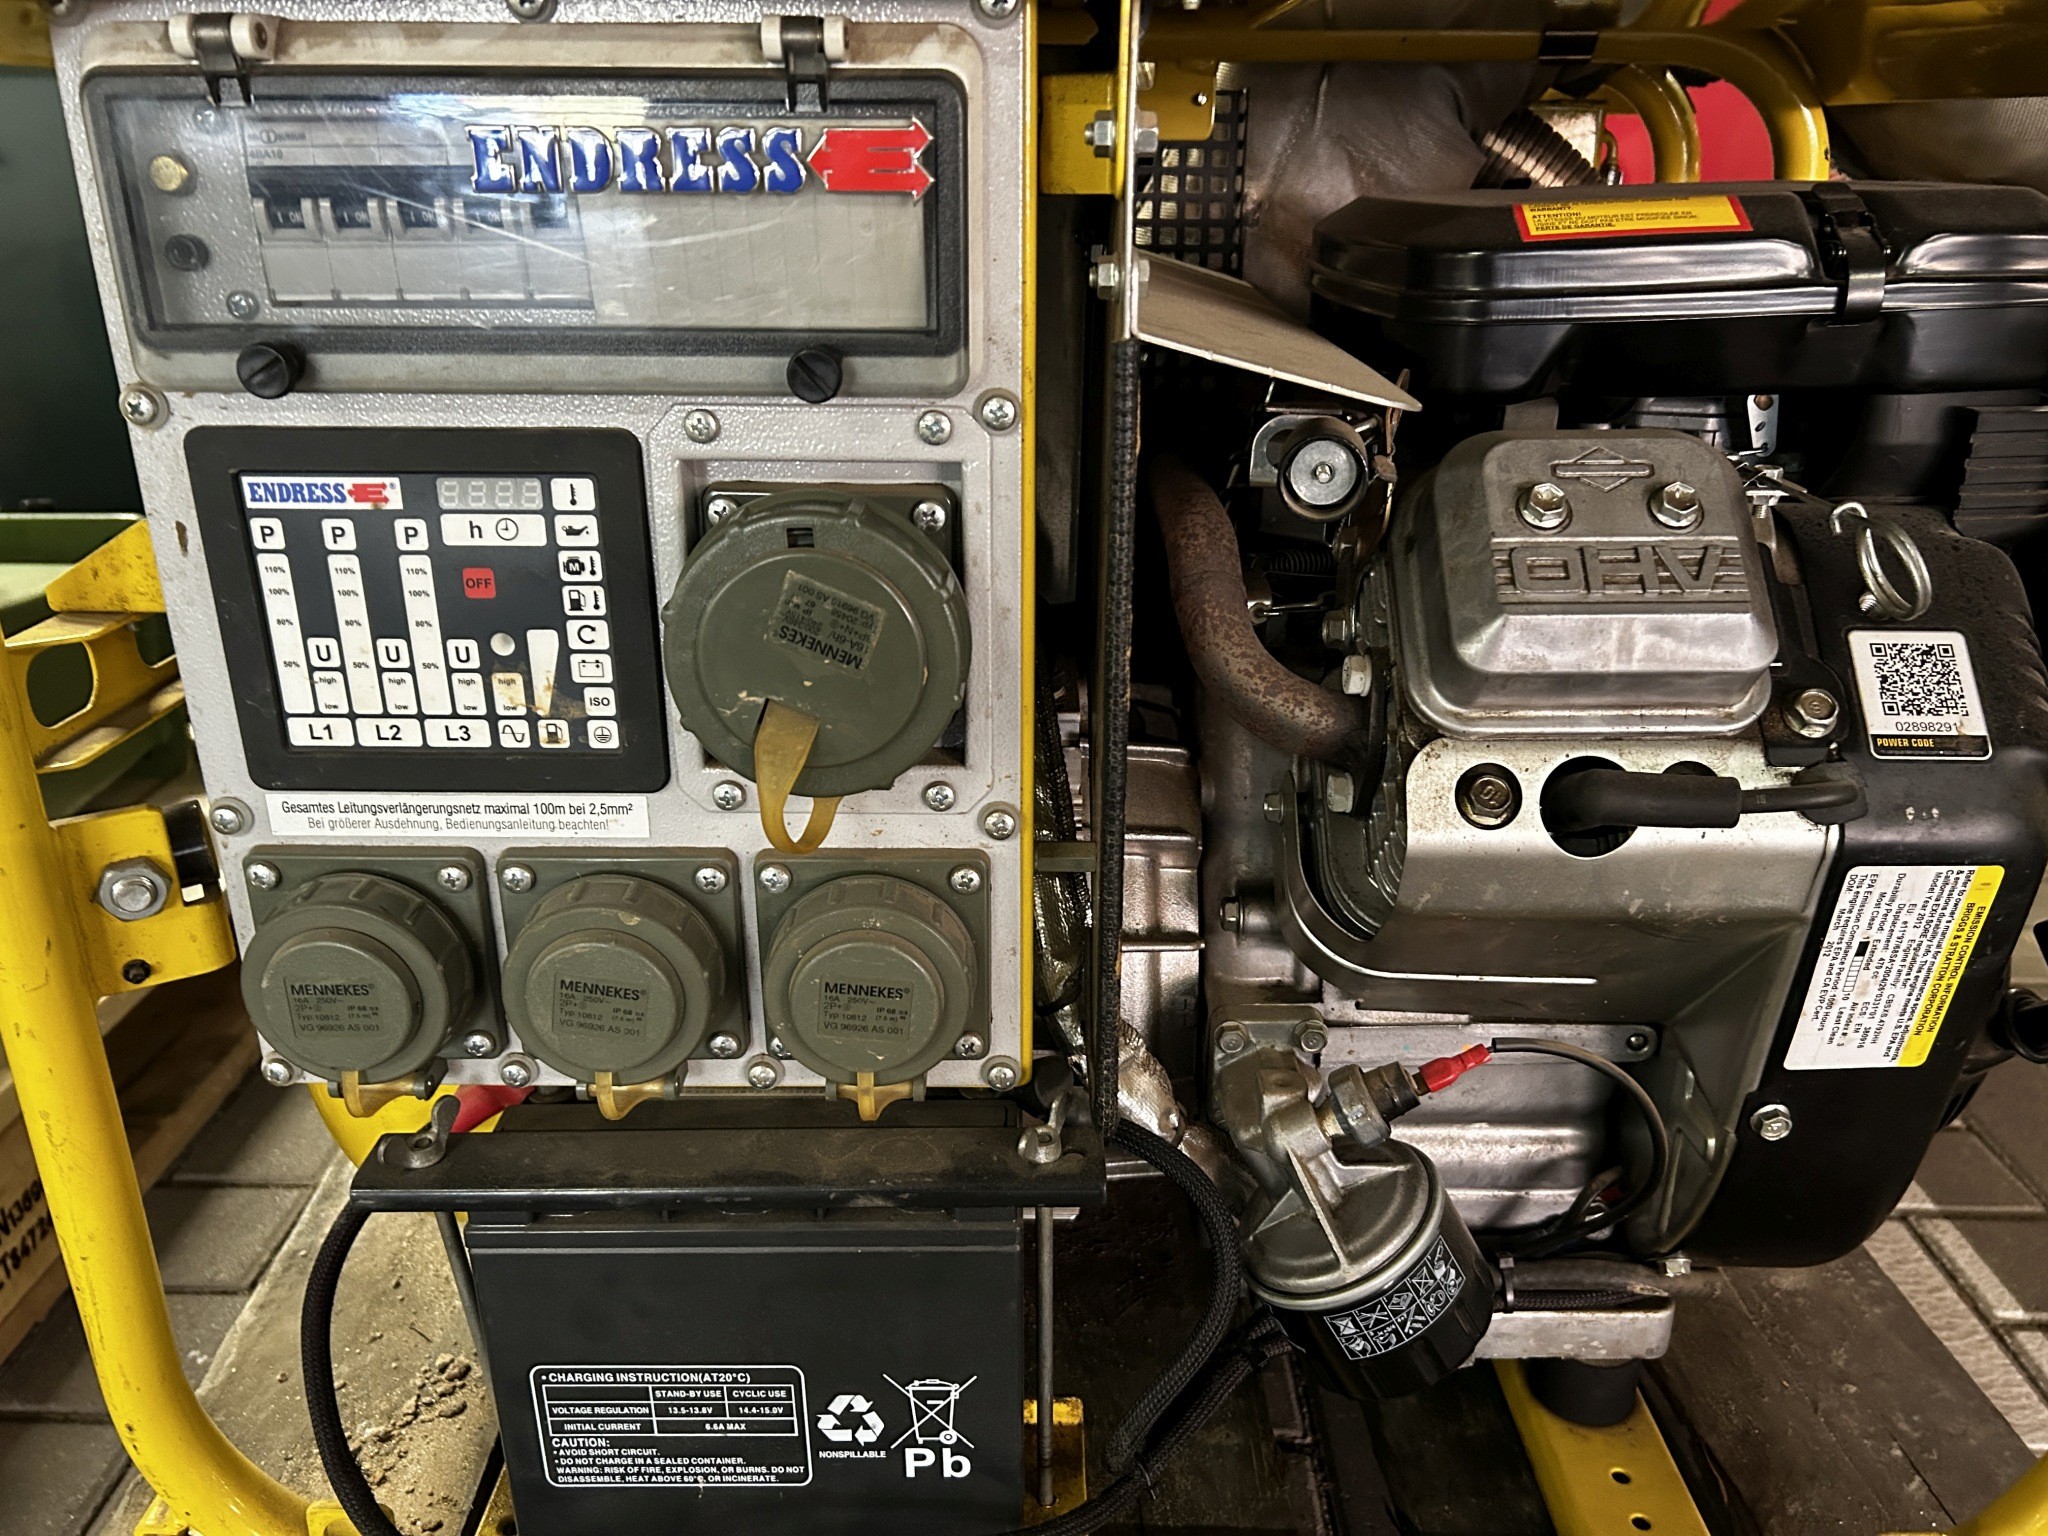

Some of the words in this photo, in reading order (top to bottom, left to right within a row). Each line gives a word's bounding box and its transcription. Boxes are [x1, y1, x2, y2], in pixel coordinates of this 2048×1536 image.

[464, 123, 808, 195] ENDRESS
[247, 482, 347, 504] ENDRESS
[260, 525, 275, 544] P
[330, 526, 346, 544] P
[404, 526, 418, 544] P
[469, 520, 483, 538] h
[264, 566, 286, 574] 110%
[406, 568, 428, 576] 110%
[1510, 545, 1724, 596] OHV
[466, 578, 492, 588] OFF
[268, 588, 290, 596] 100%
[408, 590, 430, 598] 100%
[316, 644, 332, 662] U
[384, 645, 400, 663] U
[454, 646, 470, 663] U
[778, 625, 863, 669] MENNEKES
[422, 662, 440, 670] 50%
[318, 676, 337, 685] high
[388, 677, 406, 686] high
[458, 678, 476, 686] high
[498, 678, 516, 686] high
[589, 697, 610, 707] ISO
[308, 723, 333, 740] L1
[375, 724, 402, 740] L2
[444, 725, 472, 741] L3
[1895, 722, 1958, 732] 02898291
[1876, 738, 1909, 747] POWER
[1912, 738, 1934, 747] CODE
[281, 801, 334, 814] Gesamtes
[337, 802, 481, 816] Leitungsverlängerungsnetz
[484, 802, 530, 815] maximal
[534, 803, 566, 815] 100m
[570, 803, 586, 815] bei
[589, 802, 633, 816] 2,5mm²
[308, 817, 325, 829] Bei
[328, 817, 371, 831] größerer
[374, 818, 443, 831] Ausdehnung,
[445, 818, 556, 832] Bedienungsanleitung
[559, 818, 610, 830] beachten!
[1855, 873, 1868, 888] This
[1865, 873, 1878, 888] EPA
[1927, 872, 1943, 893] Model
[1934, 869, 1954, 901] California
[1960, 869, 1975, 887] Refer
[1884, 873, 1906, 906] Durability
[1844, 890, 1861, 914] engine
[1853, 890, 1872, 923] Emission
[1873, 892, 1887, 908] Most
[1920, 895, 1933, 910] Year
[1927, 903, 1940, 917] EXH
[1945, 898, 1962, 923] owner's
[1955, 902, 1975, 932] BRIGGS
[1831, 908, 1846, 930] March
[1865, 910, 1880, 930] Clean
[1912, 912, 1926, 928] 2012
[1963, 906, 1986, 942] EMISSION
[1834, 916, 1852, 944] requires
[1879, 903, 1906, 952] Displacement:
[1918, 919, 1933, 938] SORE
[1837, 924, 1860, 965] Compliance
[1934, 925, 1951, 948] manual
[1822, 941, 1835, 957] 2012
[1830, 947, 1842, 960] EPA
[1862, 939, 1881, 970] Extended
[1898, 939, 1915, 962] Engine
[1930, 951, 1941, 959] for
[1903, 940, 1924, 976] regulations
[1935, 942, 1958, 981] STRATTON
[1946, 945, 1970, 980] CONTROL
[1825, 962, 1837, 975] and
[1915, 960, 1927, 973] This
[1821, 977, 1832, 987] CA
[1904, 975, 1920, 996] engine
[1914, 961, 1937, 1001] maintenance
[290, 984, 370, 996] MENNEKES
[560, 980, 640, 1000] MENNEKES
[824, 982, 904, 1000] MENNEKES
[1816, 989, 1828, 1003] EVP
[1848, 1001, 1859, 1011] Air
[1898, 998, 1912, 1016] meets
[1913, 983, 1942, 1035] CORPORATION
[1926, 983, 1953, 1032] INFORMATION
[1817, 1011, 1831, 1031] Hours
[1833, 1007, 1846, 1024] Least
[1841, 1013, 1855, 1030] Index
[871, 1025, 884, 1034] AS
[1826, 1026, 1840, 1044] Clean
[1887, 1032, 1899, 1044] EPA
[1882, 1045, 1893, 1056] and
[548, 1372, 614, 1383] CHARGING
[616, 1372, 751, 1384] INSTRUCTION(AT20°C)
[654, 1390, 701, 1398] STAND-BY
[703, 1390, 722, 1398] USE
[732, 1390, 766, 1398] CYCLIC
[768, 1390, 787, 1398] USE
[552, 1406, 593, 1414] VOLTAGE
[594, 1406, 650, 1414] REGULATION
[668, 1406, 713, 1414] 13.5-13.8V
[564, 1423, 597, 1431] INITIAL
[598, 1423, 641, 1431] CURRENT
[552, 1438, 610, 1448] CAUTION:
[558, 1448, 588, 1456] AVOID
[588, 1448, 620, 1456] SHORT
[620, 1448, 660, 1456] CIRCUIT.
[819, 1450, 886, 1459] NONSPILLABLE
[690, 1457, 746, 1465] CONTAINER.
[904, 1448, 971, 1478] Pb
[556, 1466, 603, 1474] WARNING:
[604, 1466, 626, 1474] RISK
[627, 1466, 639, 1474] OF
[640, 1466, 665, 1474] FIRE,
[665, 1466, 720, 1474] EXPLOSION,
[721, 1466, 734, 1474] OR
[736, 1466, 770, 1474] BURNS.
[771, 1466, 784, 1474] DO
[558, 1475, 624, 1483] DISASSEMBLE,
